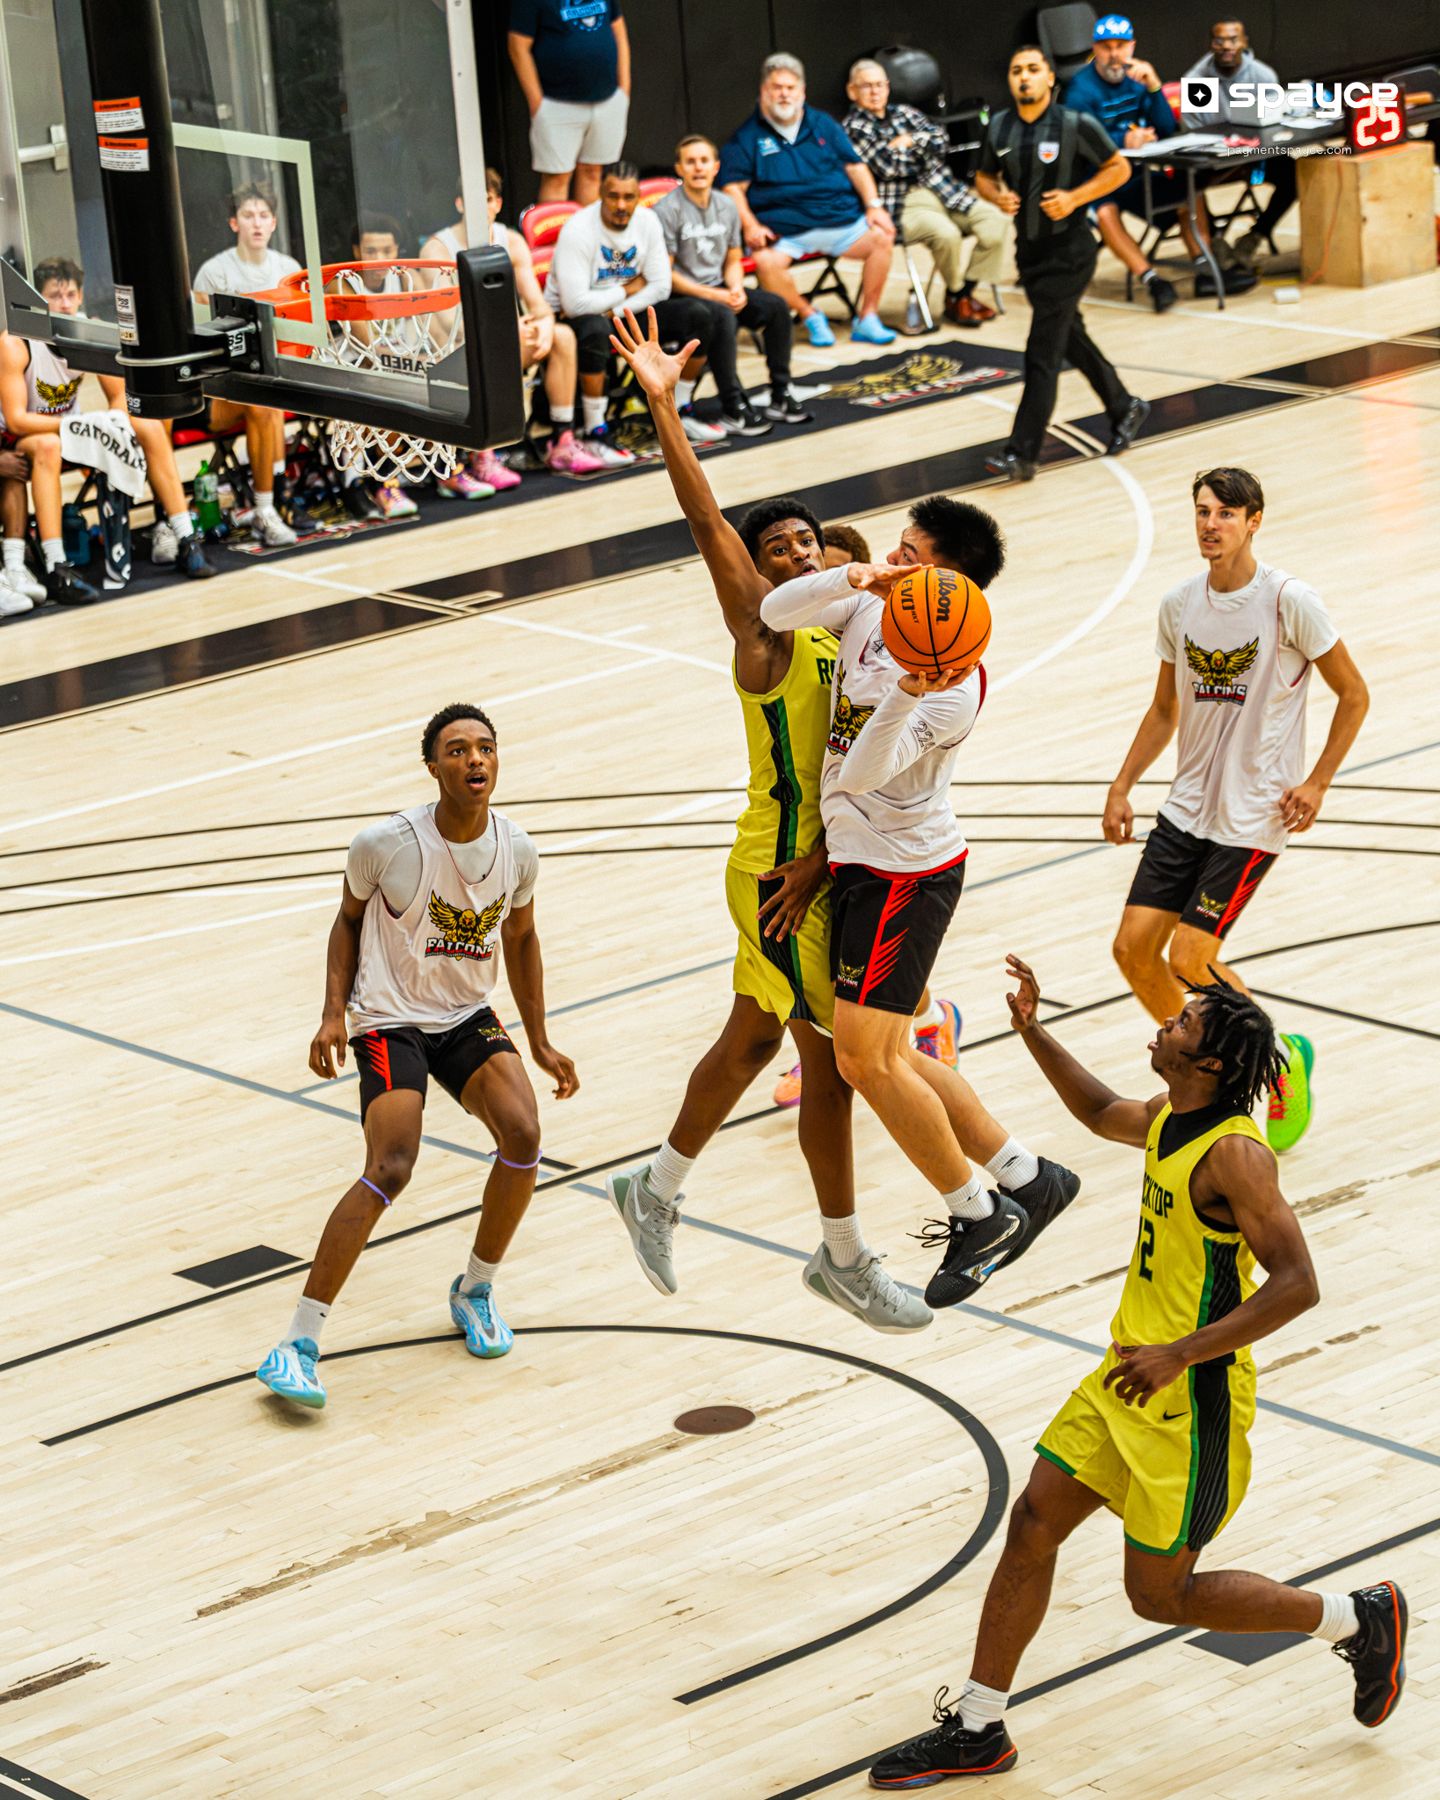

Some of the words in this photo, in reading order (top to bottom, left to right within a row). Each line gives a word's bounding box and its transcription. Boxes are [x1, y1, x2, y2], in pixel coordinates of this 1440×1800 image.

[1356, 95, 1401, 147] 25
[901, 579, 915, 611] EVO
[426, 938, 495, 958] FALCONS
